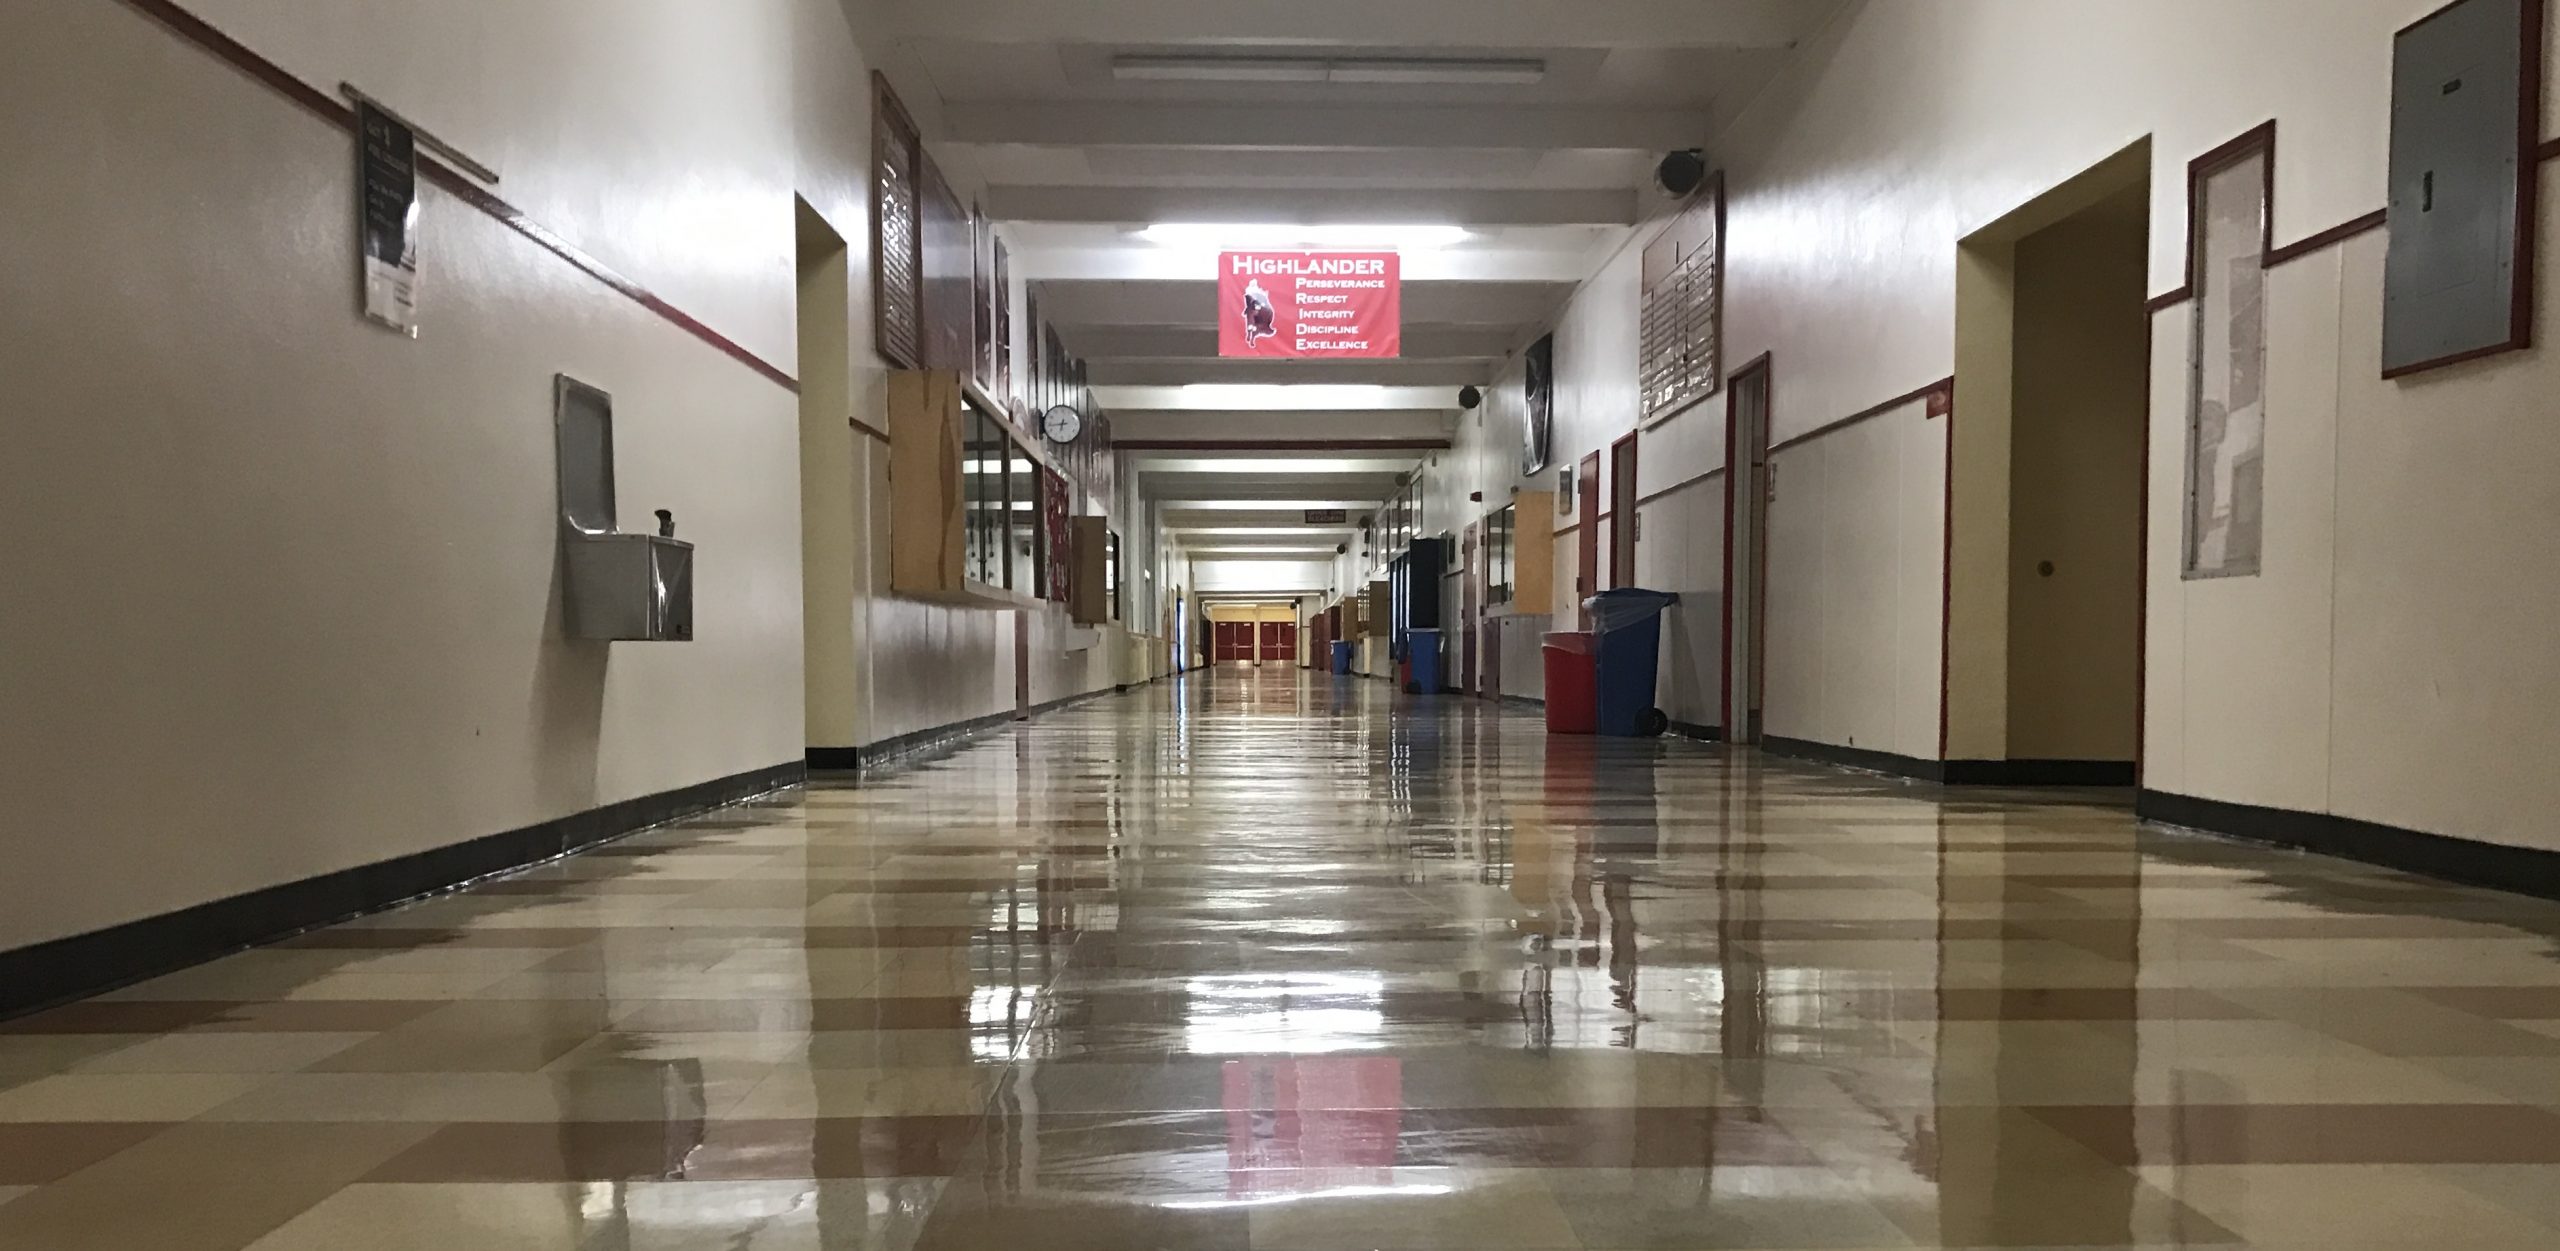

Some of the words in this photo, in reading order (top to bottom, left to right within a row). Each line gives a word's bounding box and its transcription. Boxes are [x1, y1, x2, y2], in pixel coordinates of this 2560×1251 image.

[1232, 255, 1385, 275] HIGHLANDER
[1295, 277, 1385, 289] PERSEVERANCE
[1295, 293, 1348, 304] RESPECT
[1299, 308, 1355, 319] INTEGRITY
[1295, 323, 1359, 335] DISCIPLINE
[1295, 338, 1368, 350] EXCELLENCE
